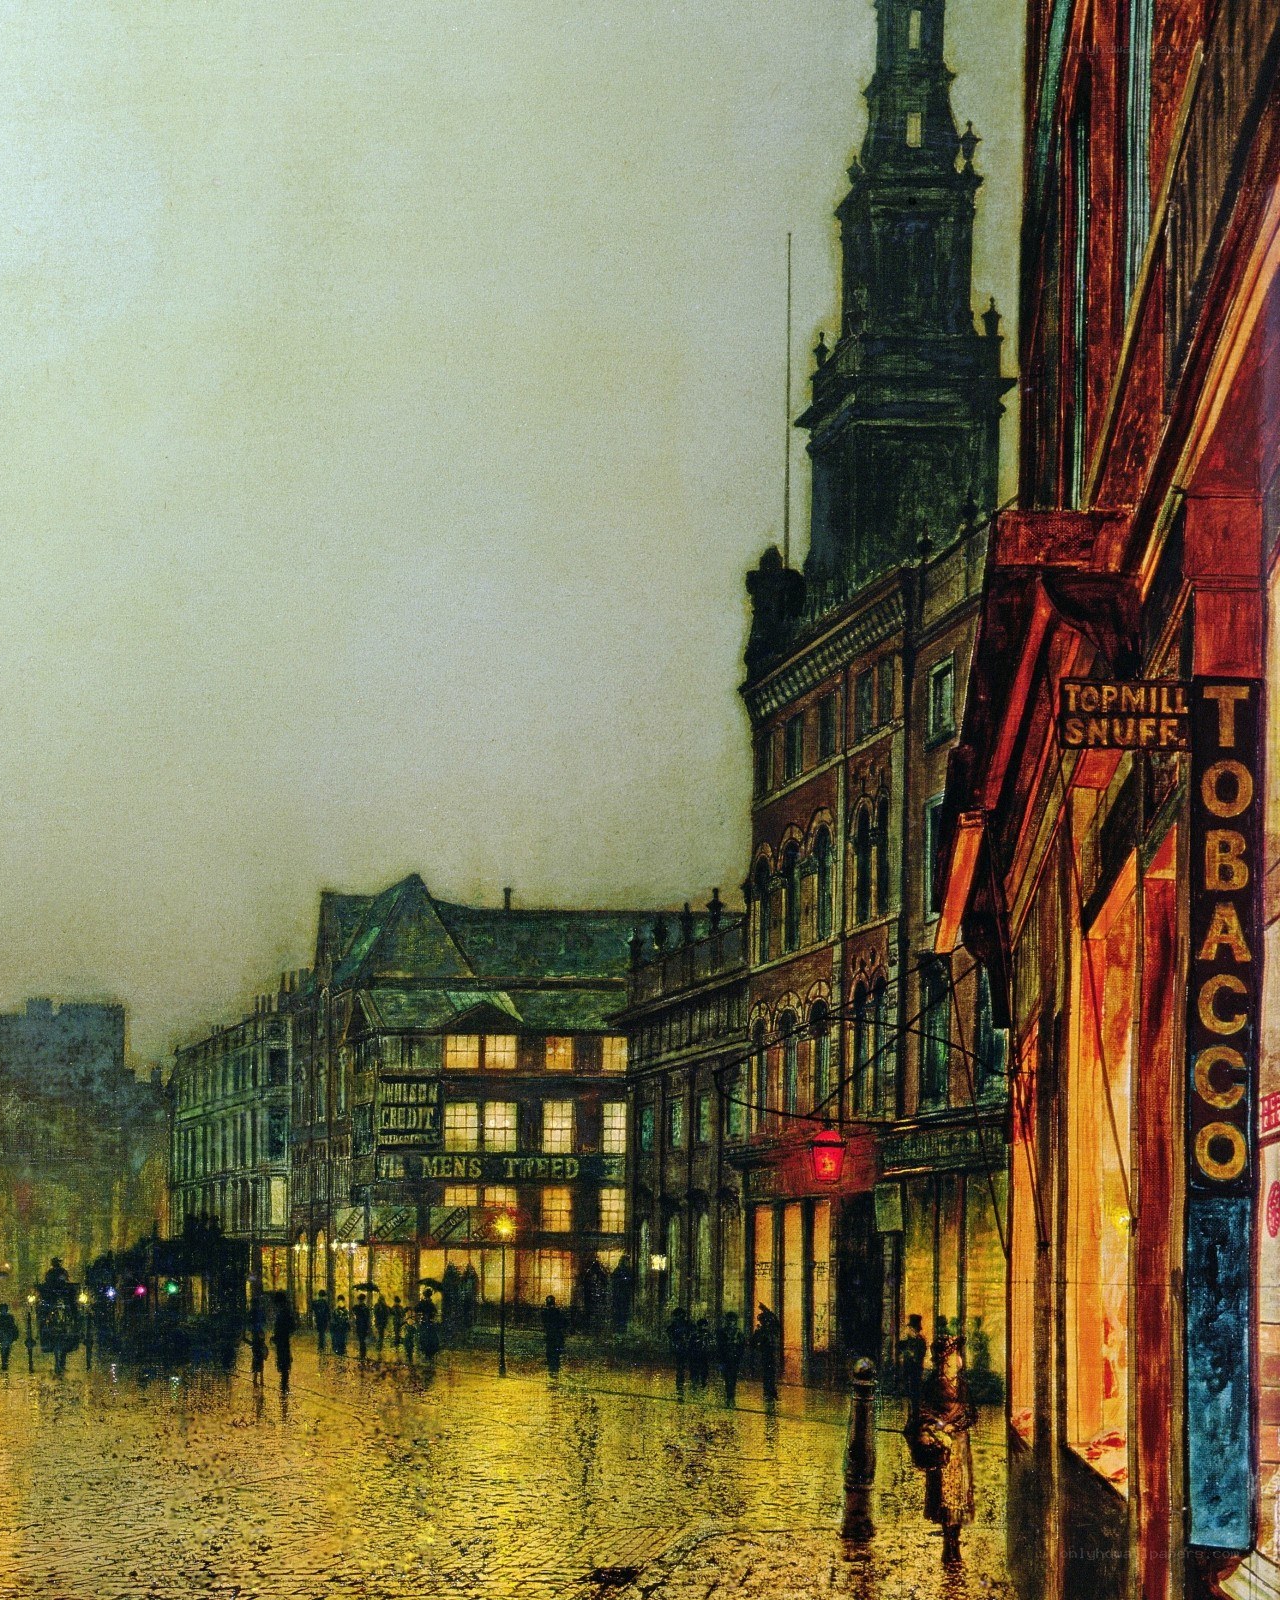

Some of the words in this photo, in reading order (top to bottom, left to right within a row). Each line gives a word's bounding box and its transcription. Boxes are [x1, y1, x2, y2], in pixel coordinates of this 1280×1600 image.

[1064, 684, 1189, 715] TOPMILL
[1195, 685, 1254, 1181] TOBACCO
[381, 1107, 434, 1129] CREDIT
[422, 1156, 483, 1179] MENS
[503, 1156, 581, 1180] TWEED
